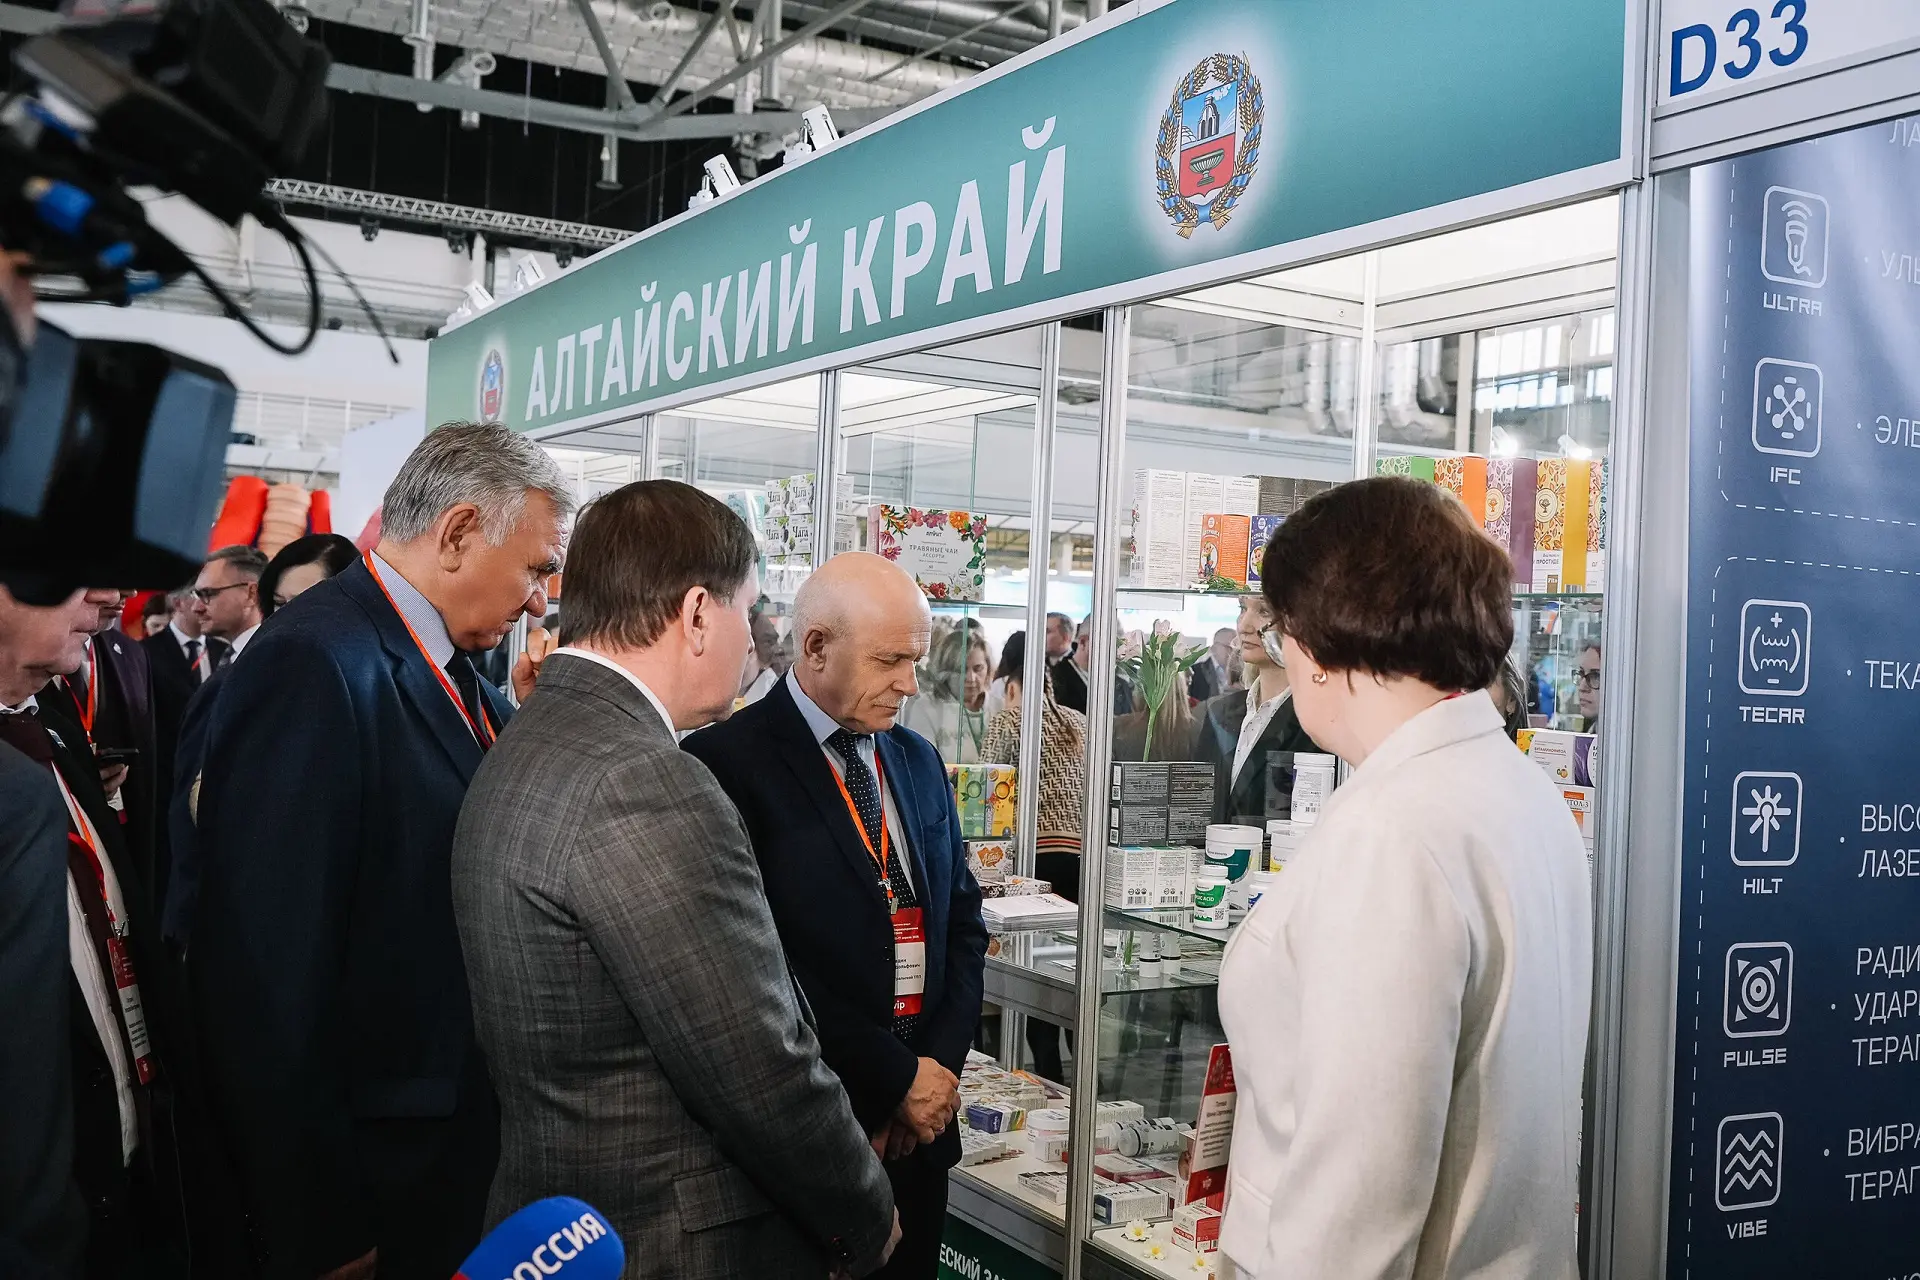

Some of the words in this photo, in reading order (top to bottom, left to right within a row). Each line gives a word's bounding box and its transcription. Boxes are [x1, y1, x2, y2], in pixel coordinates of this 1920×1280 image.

[1670, 0, 1809, 97] D33
[525, 218, 818, 422] АЛТАЙСКИЙ
[839, 115, 1067, 334] КРАЙ
[1763, 292, 1823, 317] ULTRA
[1874, 415, 1920, 448] ЭЛЕ
[1770, 466, 1801, 485] IFC
[909, 544, 943, 554] ТРАВЯНЫЕ
[945, 547, 958, 555] ЧАИ
[1738, 705, 1805, 724] TECAR
[1858, 848, 1920, 878] ЛАЗЕ
[1743, 878, 1783, 894] HILT
[1856, 944, 1920, 979] РАДИ
[1854, 989, 1920, 1026] УДАР
[1723, 1047, 1788, 1068] PULSE
[1726, 1219, 1768, 1240] VIBE
[502, 1212, 607, 1280] ОССИЯ
